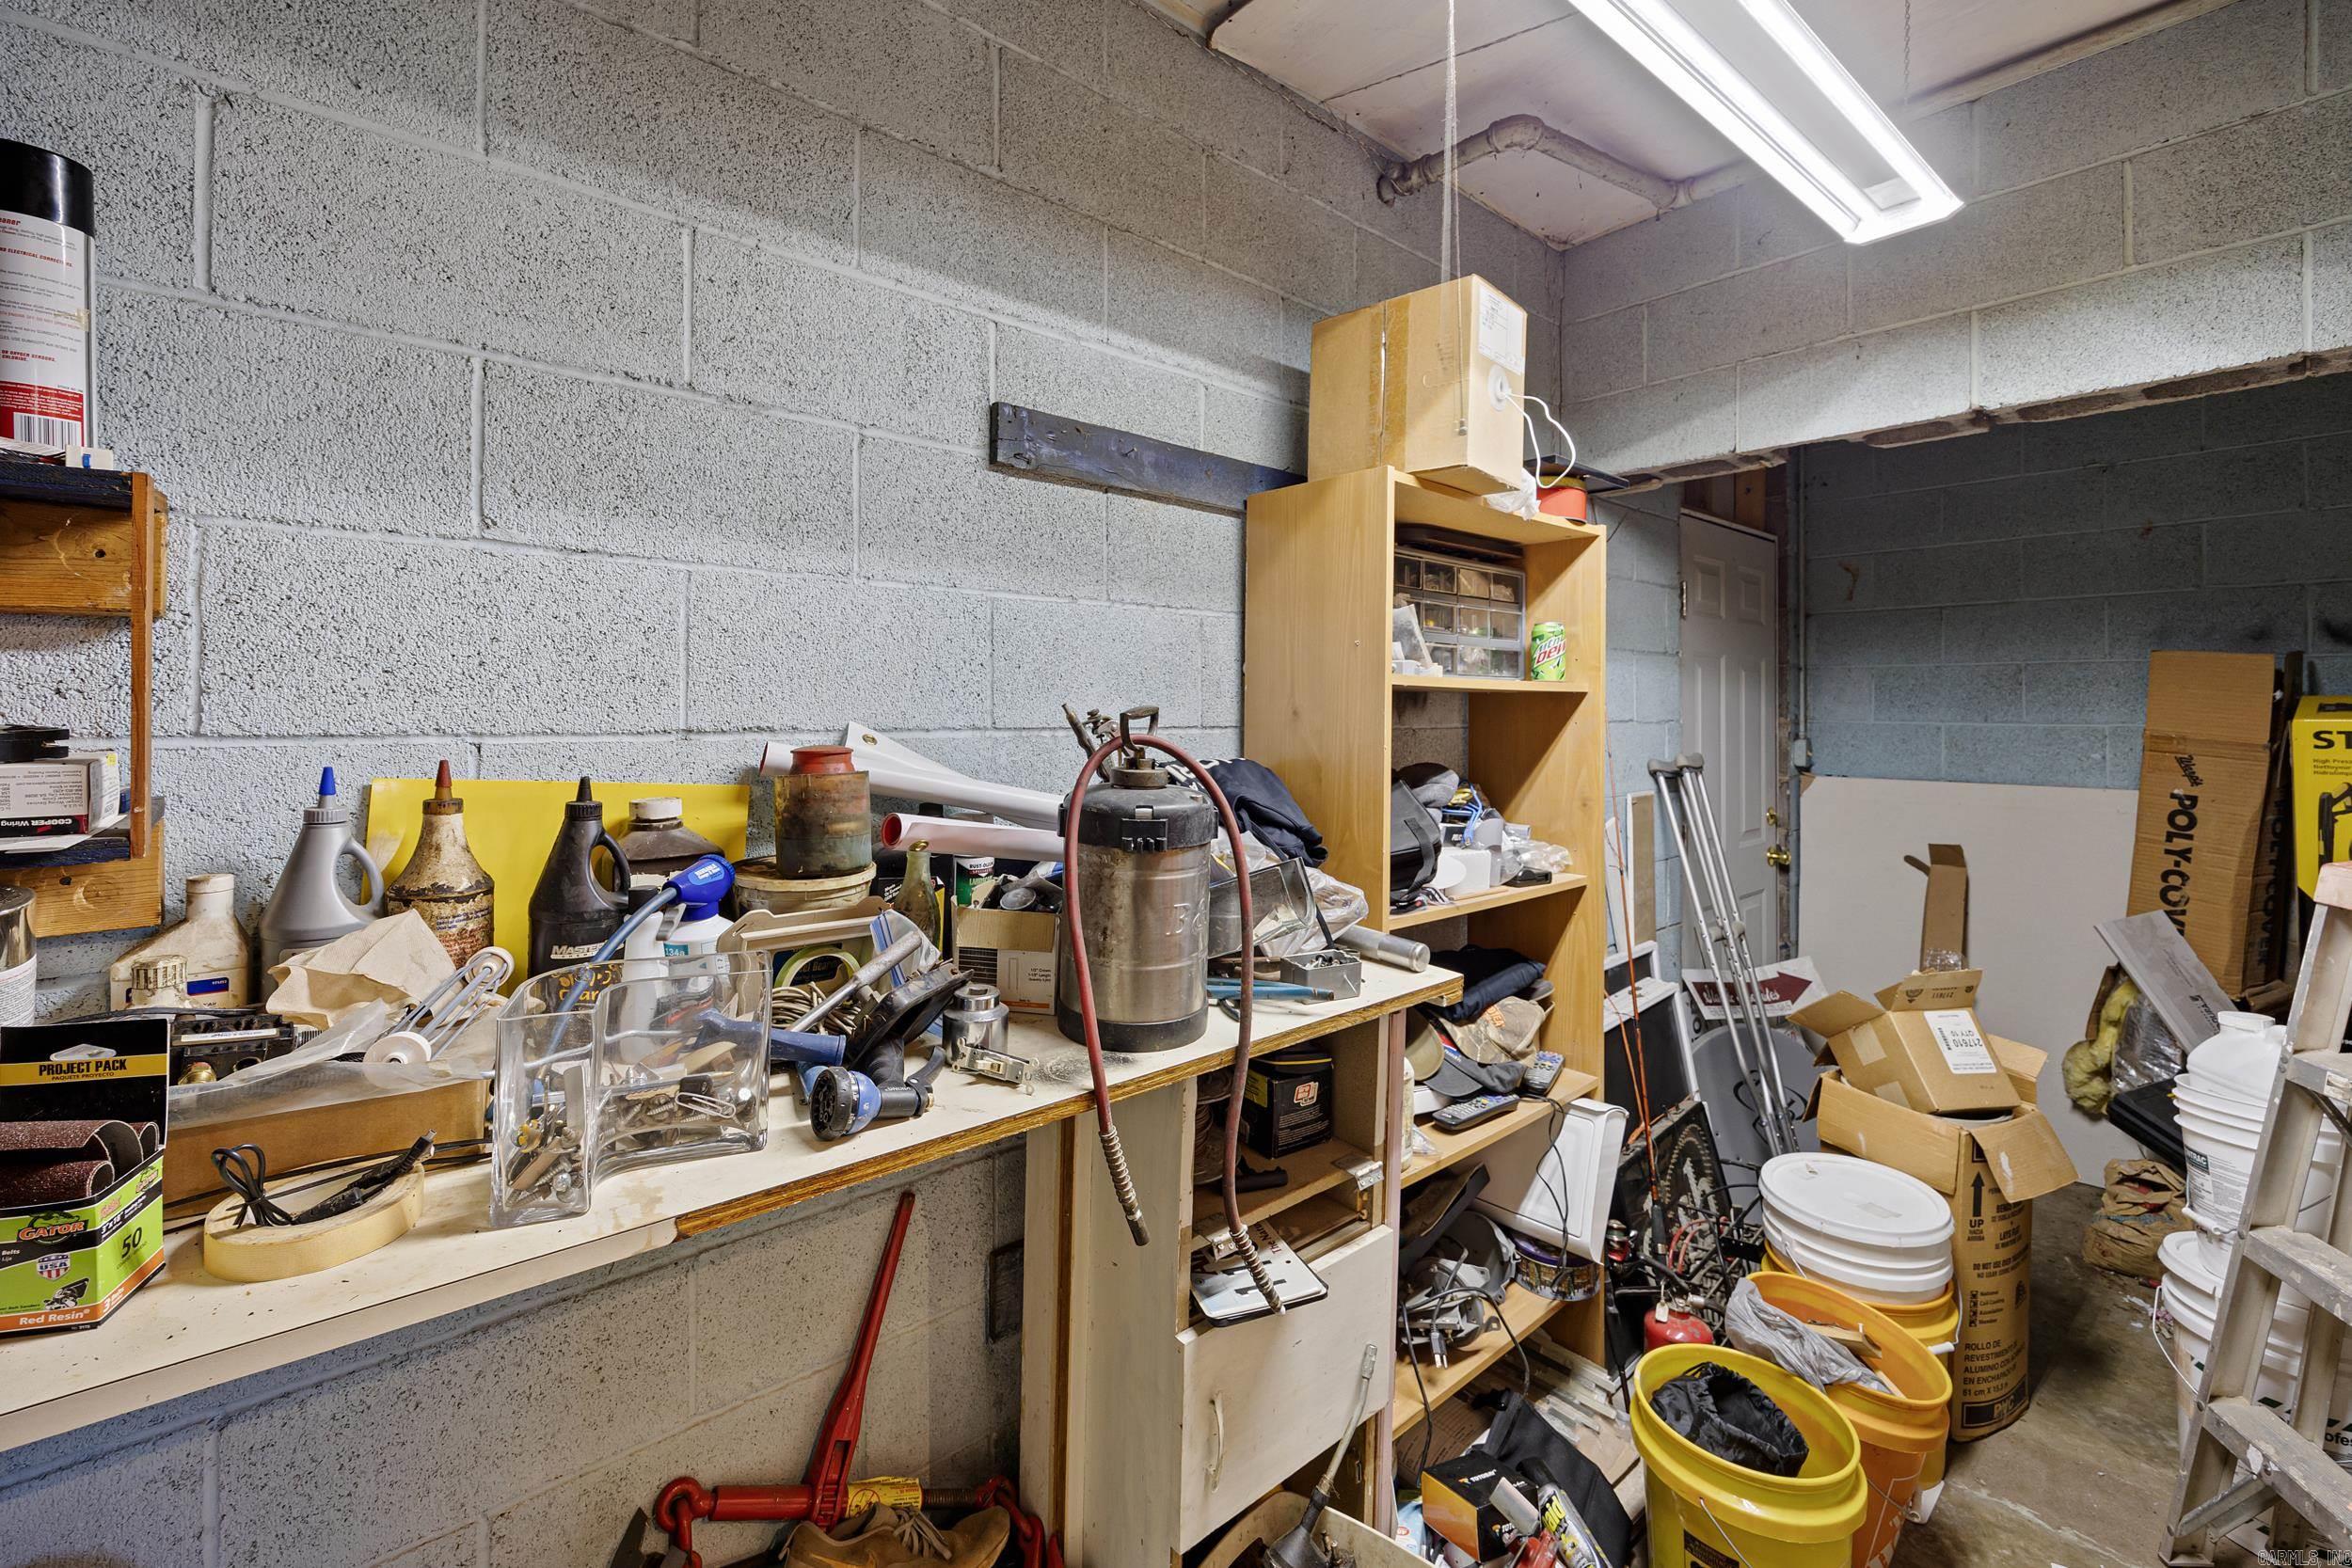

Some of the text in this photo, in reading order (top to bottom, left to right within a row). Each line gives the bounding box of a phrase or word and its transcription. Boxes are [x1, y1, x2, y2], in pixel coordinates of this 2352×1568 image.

[1, 818, 29, 827] Wiring
[2159, 791, 2199, 939] POLY-COV
[39, 1059, 127, 1076] PROJECT PACK
[1969, 1219, 1984, 1228] UP
[18, 1222, 85, 1241] GATOR
[121, 1227, 143, 1259] 50
[40, 1261, 68, 1271] USA
[103, 1299, 111, 1313] 3
[19, 1314, 45, 1325] Red
[1964, 1338, 2002, 1352] ROLLO DE
[1963, 1362, 1999, 1373] ALUMINIO
[1963, 1377, 1975, 1386] EN
[1541, 1495, 1566, 1533] aid
